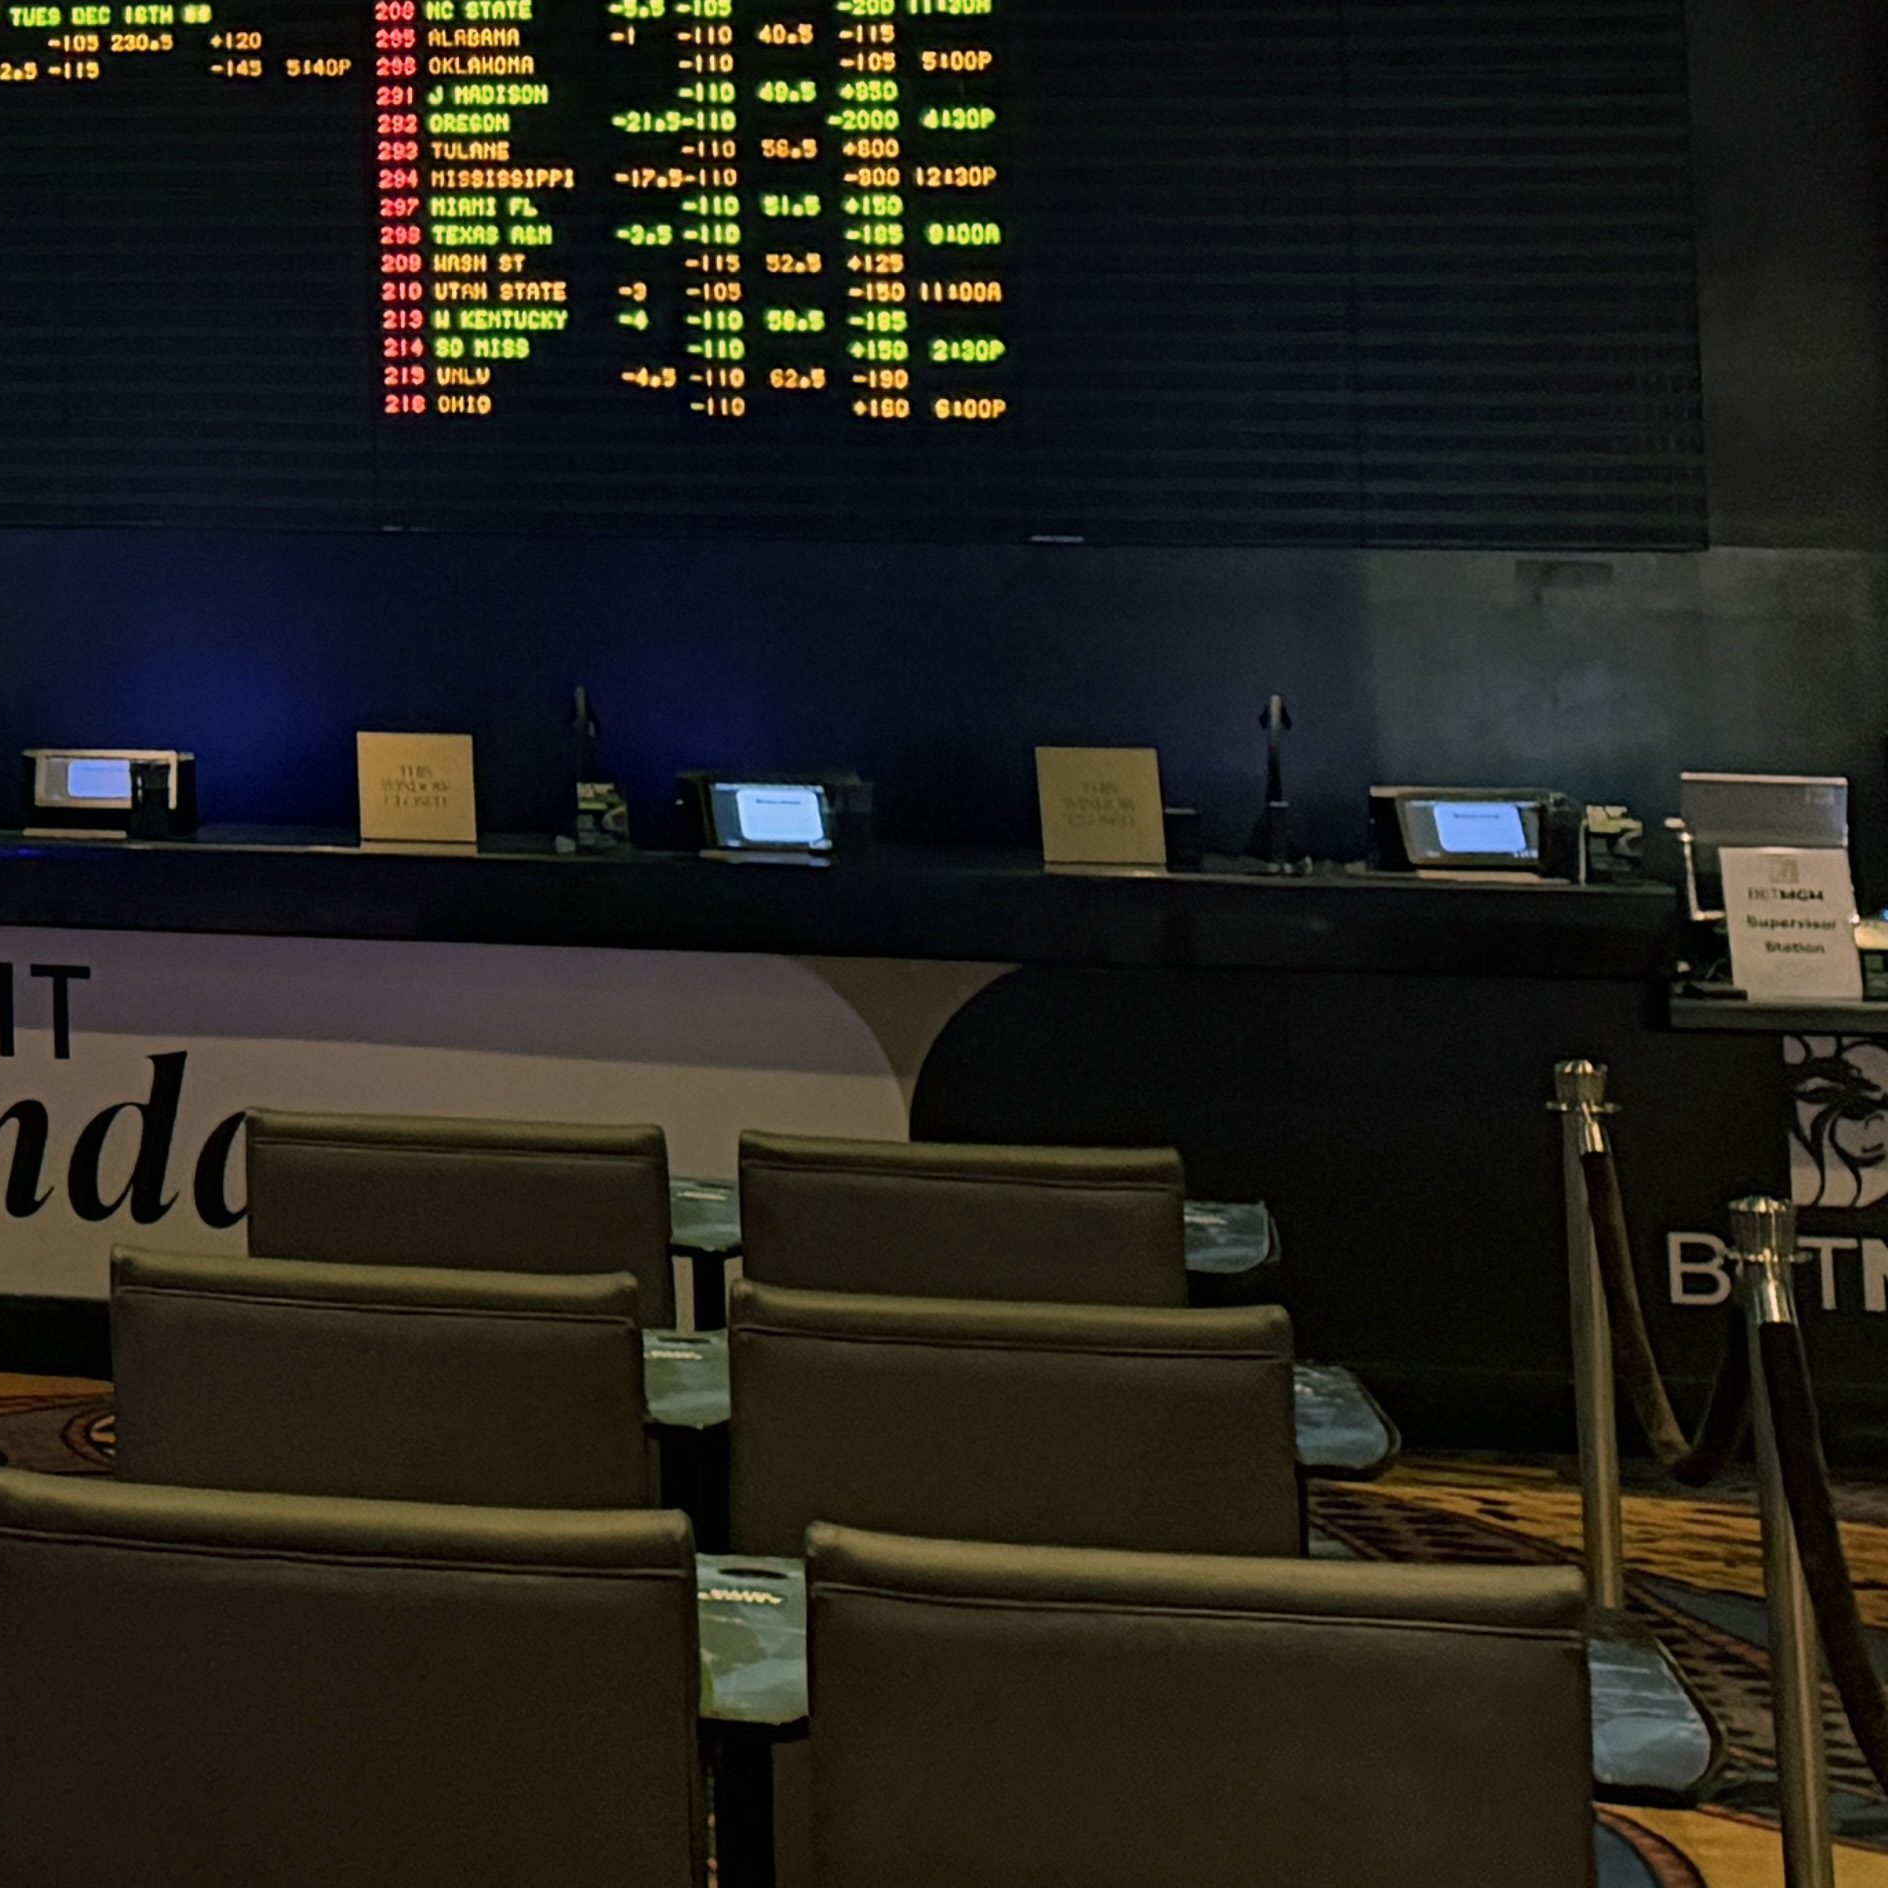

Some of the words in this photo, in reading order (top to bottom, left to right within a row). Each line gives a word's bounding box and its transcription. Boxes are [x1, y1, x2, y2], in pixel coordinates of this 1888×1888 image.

[9, 7, 61, 27] TUES
[71, 6, 111, 25] DEC
[428, 27, 520, 48] ALABAMA
[429, 55, 534, 75] OKLAHOMA
[452, 84, 549, 106] MADISON
[427, 112, 510, 134] OREGON
[431, 141, 509, 161] TULANE
[431, 168, 574, 188] MISSISSIPPI
[429, 196, 496, 217] MIAMI
[508, 196, 538, 217] FL
[431, 224, 499, 246] TEXAS
[434, 281, 488, 301] UTAH
[500, 281, 566, 302] STATE
[458, 308, 568, 330] KENTUCKY
[438, 395, 491, 414] OHIO
[1746, 914, 1837, 930] Supervisor
[1765, 941, 1825, 954] Station
